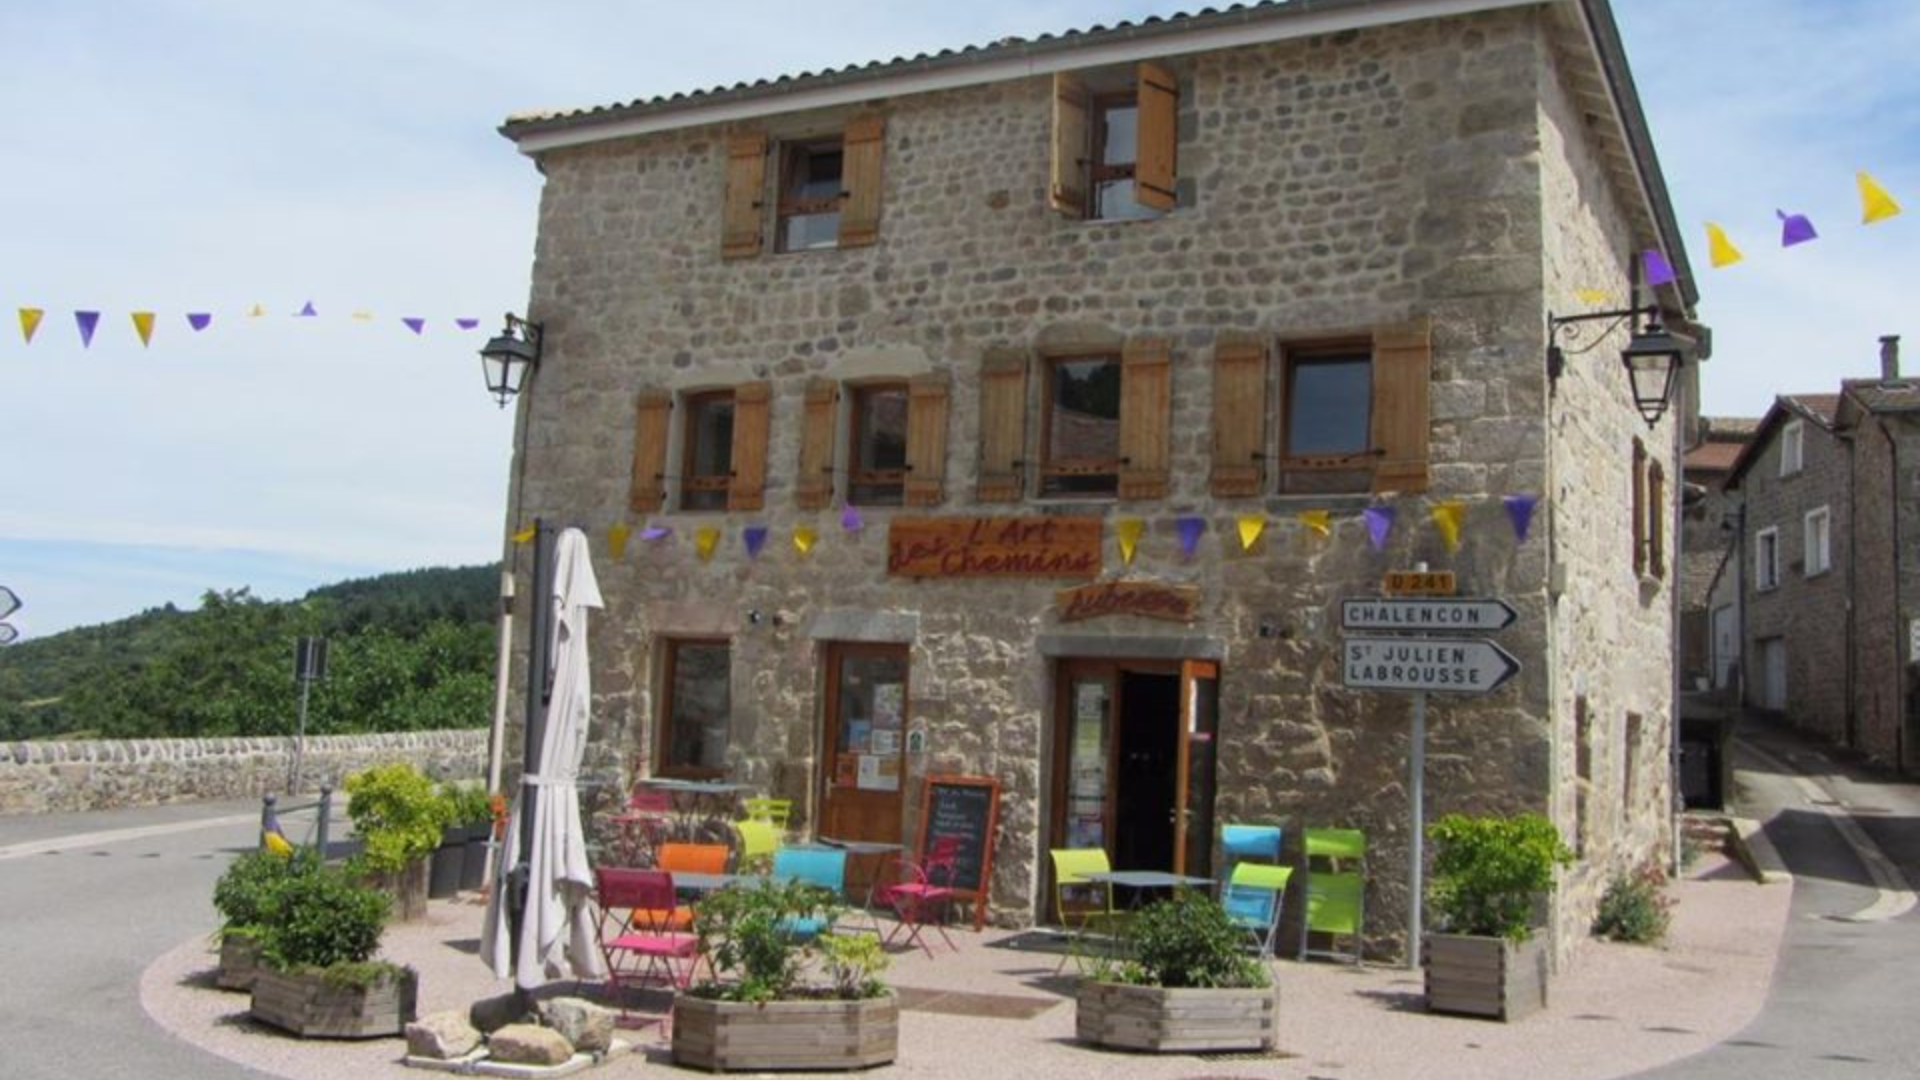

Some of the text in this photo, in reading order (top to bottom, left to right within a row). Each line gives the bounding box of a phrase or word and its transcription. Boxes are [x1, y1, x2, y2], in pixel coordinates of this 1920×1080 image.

[941, 546, 1097, 574] Chemins
[1411, 574, 1447, 590] 241
[1349, 607, 1479, 623] CHALENCON
[1383, 647, 1465, 663] JULIEN
[1350, 665, 1480, 684] LABROUSSE
